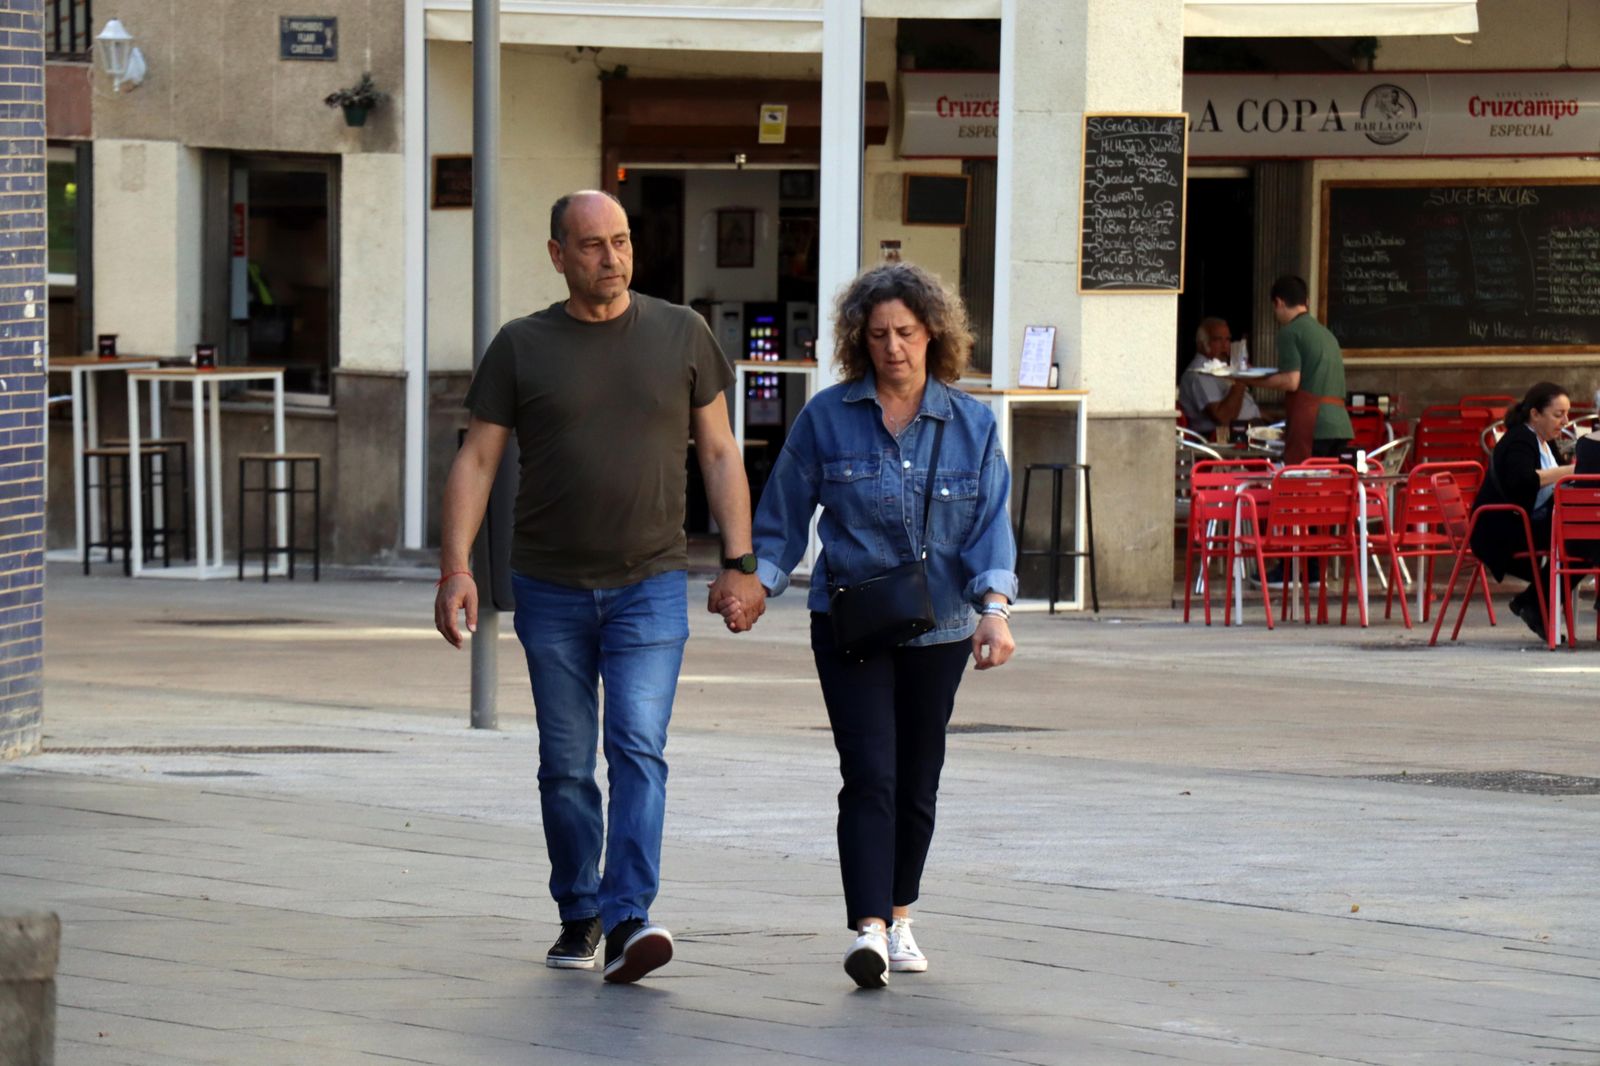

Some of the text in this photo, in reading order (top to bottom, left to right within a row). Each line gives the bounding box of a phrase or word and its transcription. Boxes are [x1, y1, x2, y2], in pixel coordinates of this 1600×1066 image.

[1236, 98, 1346, 133] COPA
[1468, 95, 1579, 120] Cruzcampo
[1354, 121, 1422, 131] BAR LA COPA
[1489, 124, 1553, 137] ESPECIAL
[1424, 187, 1539, 207] SUGERENCIAS
